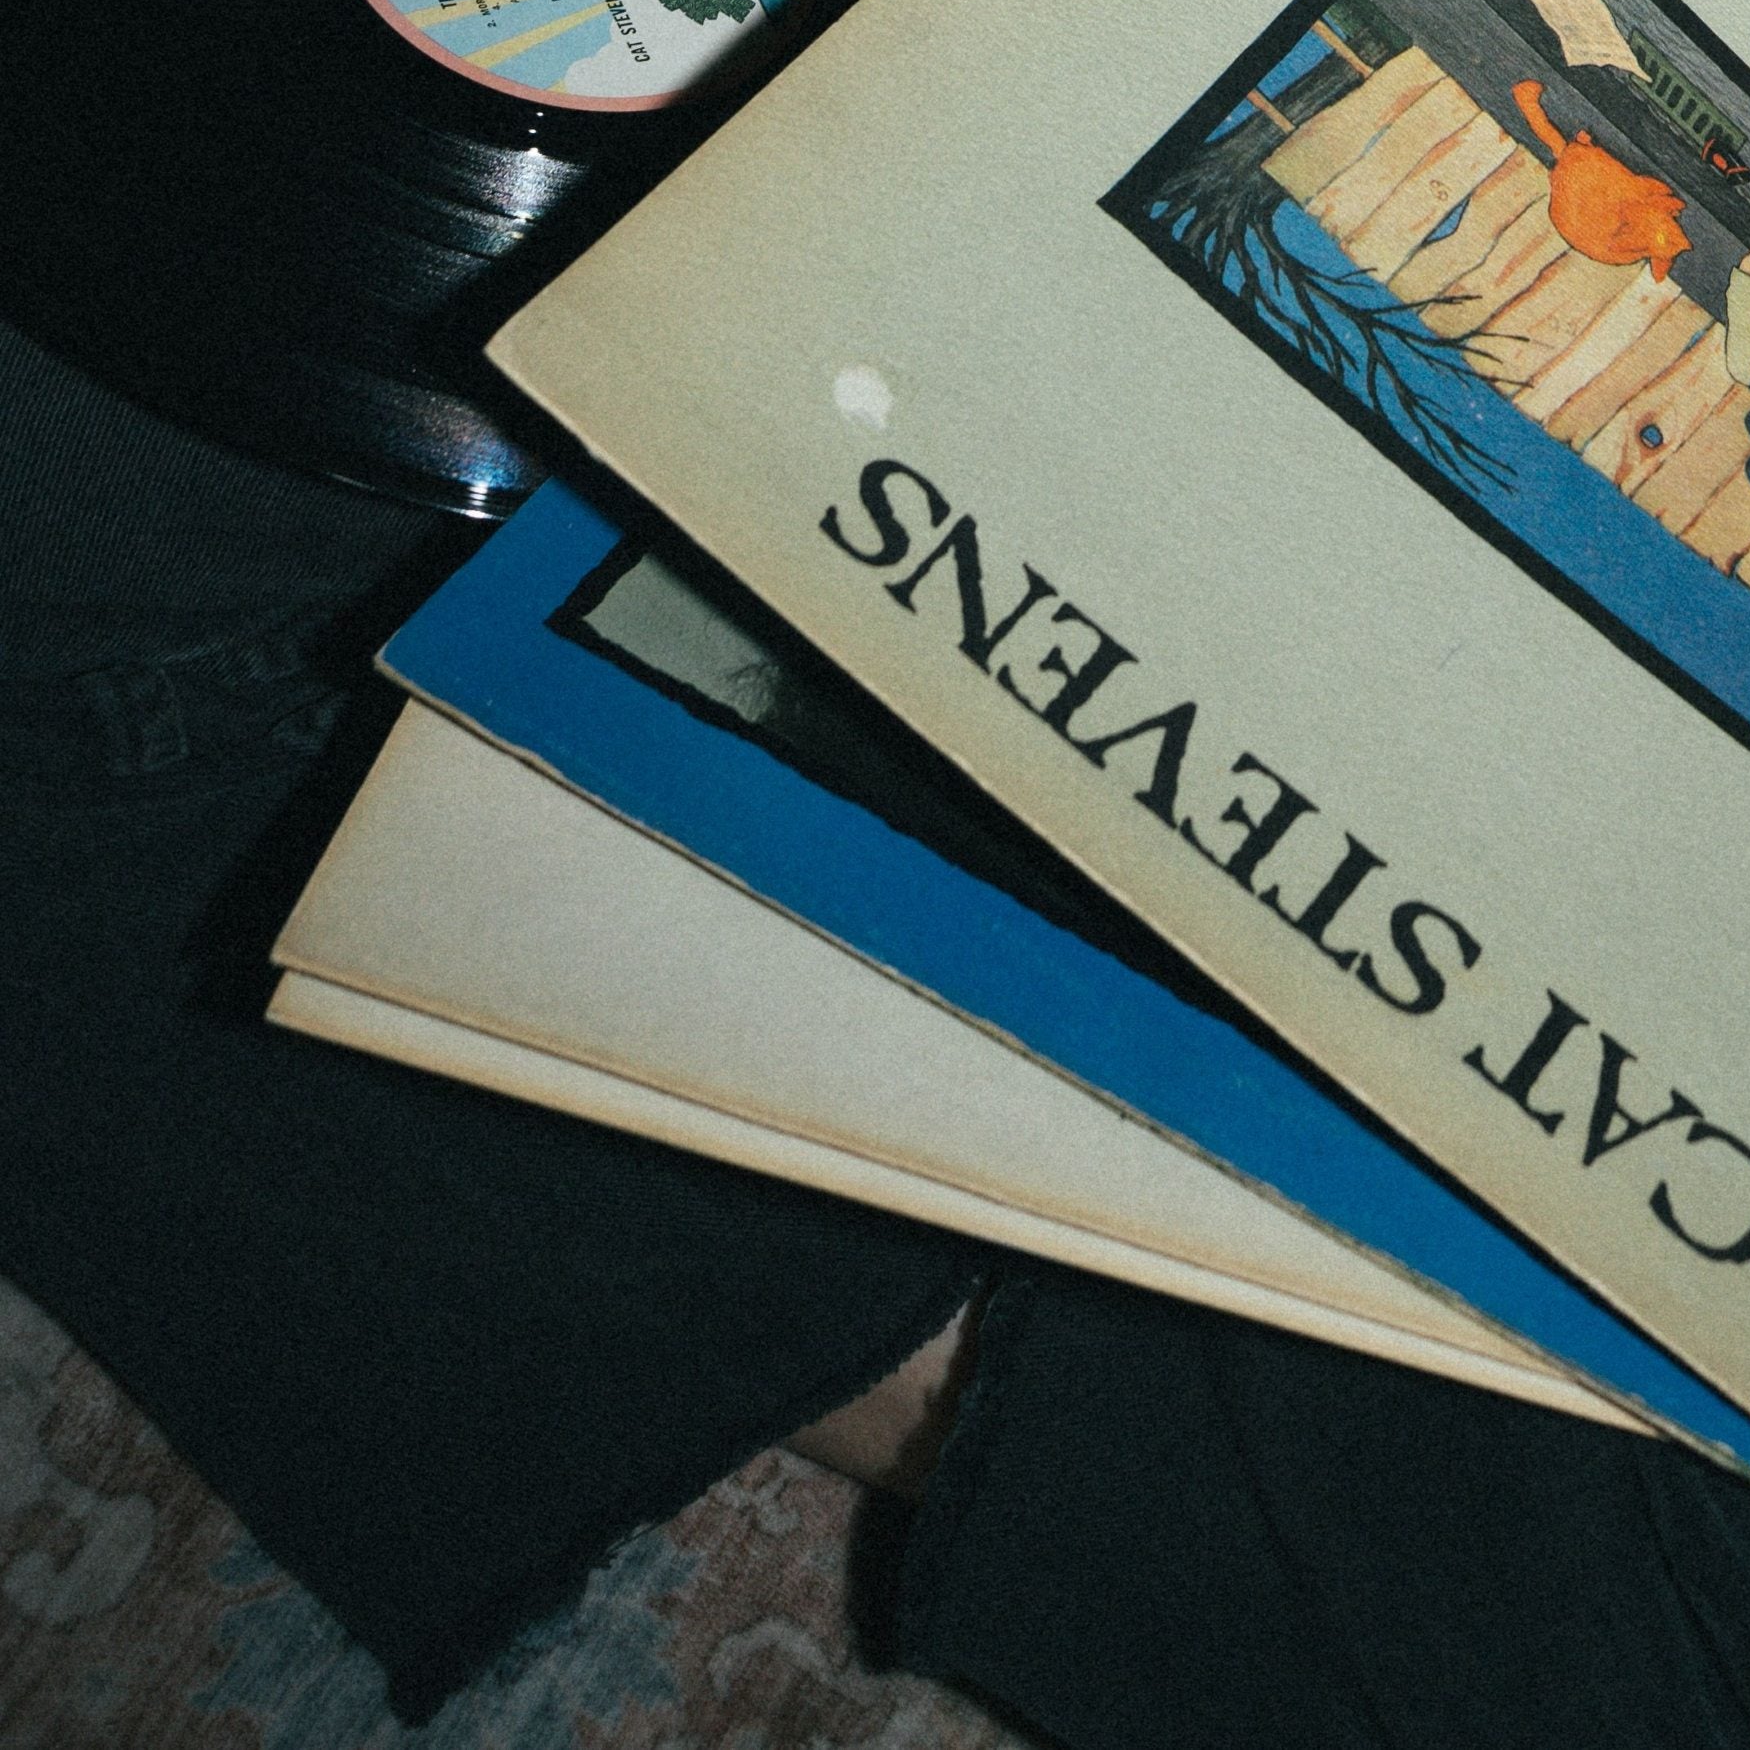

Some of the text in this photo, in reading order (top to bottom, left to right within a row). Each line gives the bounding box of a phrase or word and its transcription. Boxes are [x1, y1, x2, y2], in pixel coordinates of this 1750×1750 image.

[488, 20, 496, 28] 2.
[626, 42, 650, 62] CAT
[818, 457, 1483, 1016] STEVENS
